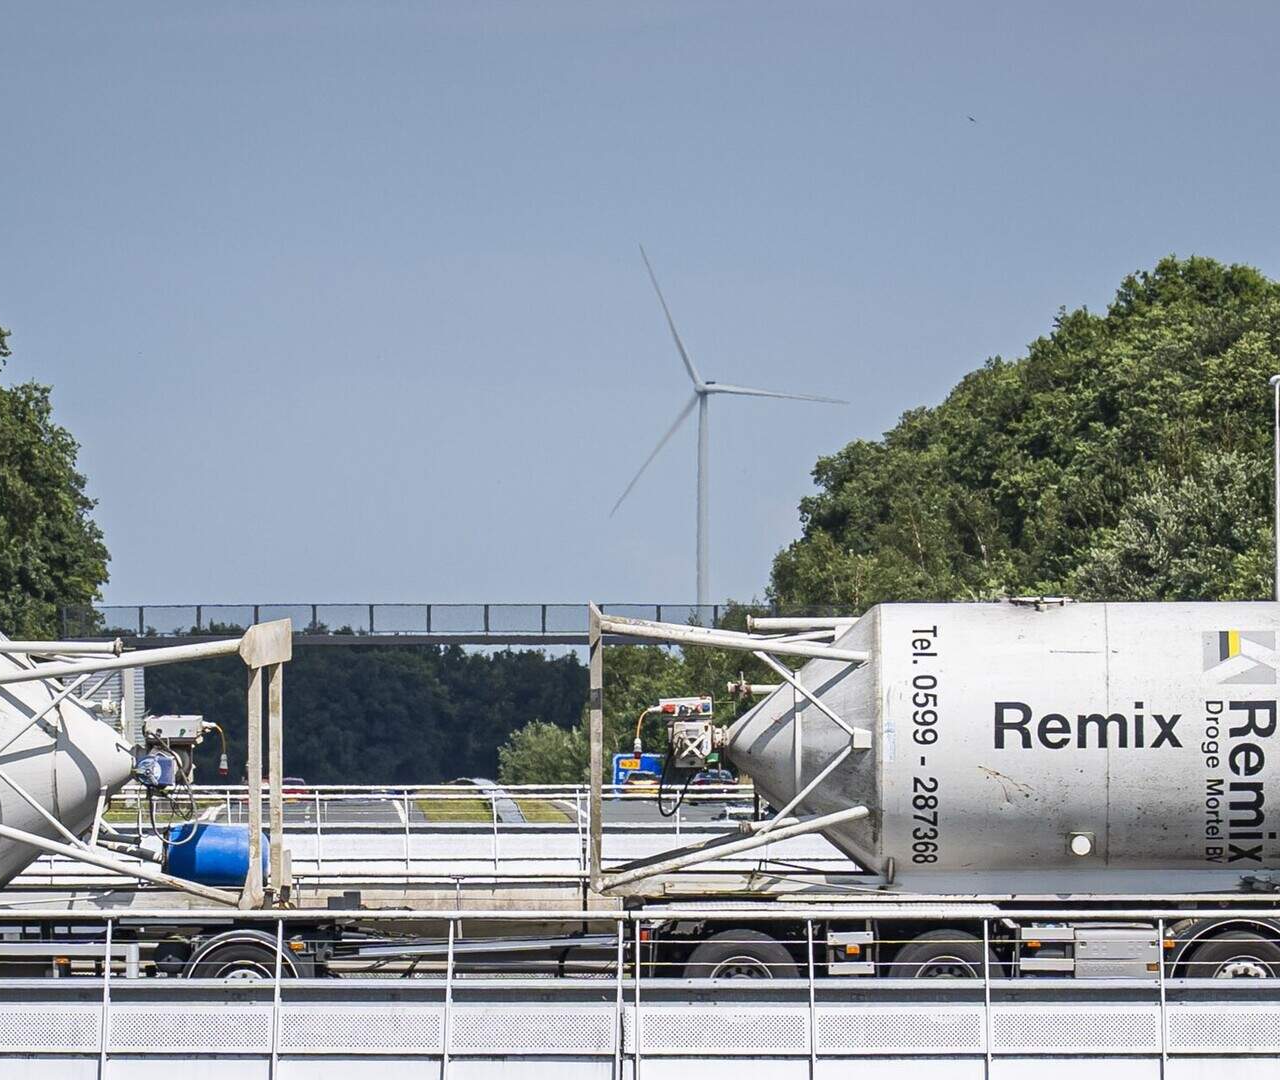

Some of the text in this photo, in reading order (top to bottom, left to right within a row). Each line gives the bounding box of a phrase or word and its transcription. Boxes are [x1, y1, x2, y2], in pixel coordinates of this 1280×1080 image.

[912, 625, 938, 665] Tel.
[912, 675, 938, 745] 0599
[994, 701, 1183, 750] Remix
[912, 776, 939, 865] 287368
[1202, 700, 1225, 864] Droge Mortel BV
[1228, 700, 1277, 863] Remix
